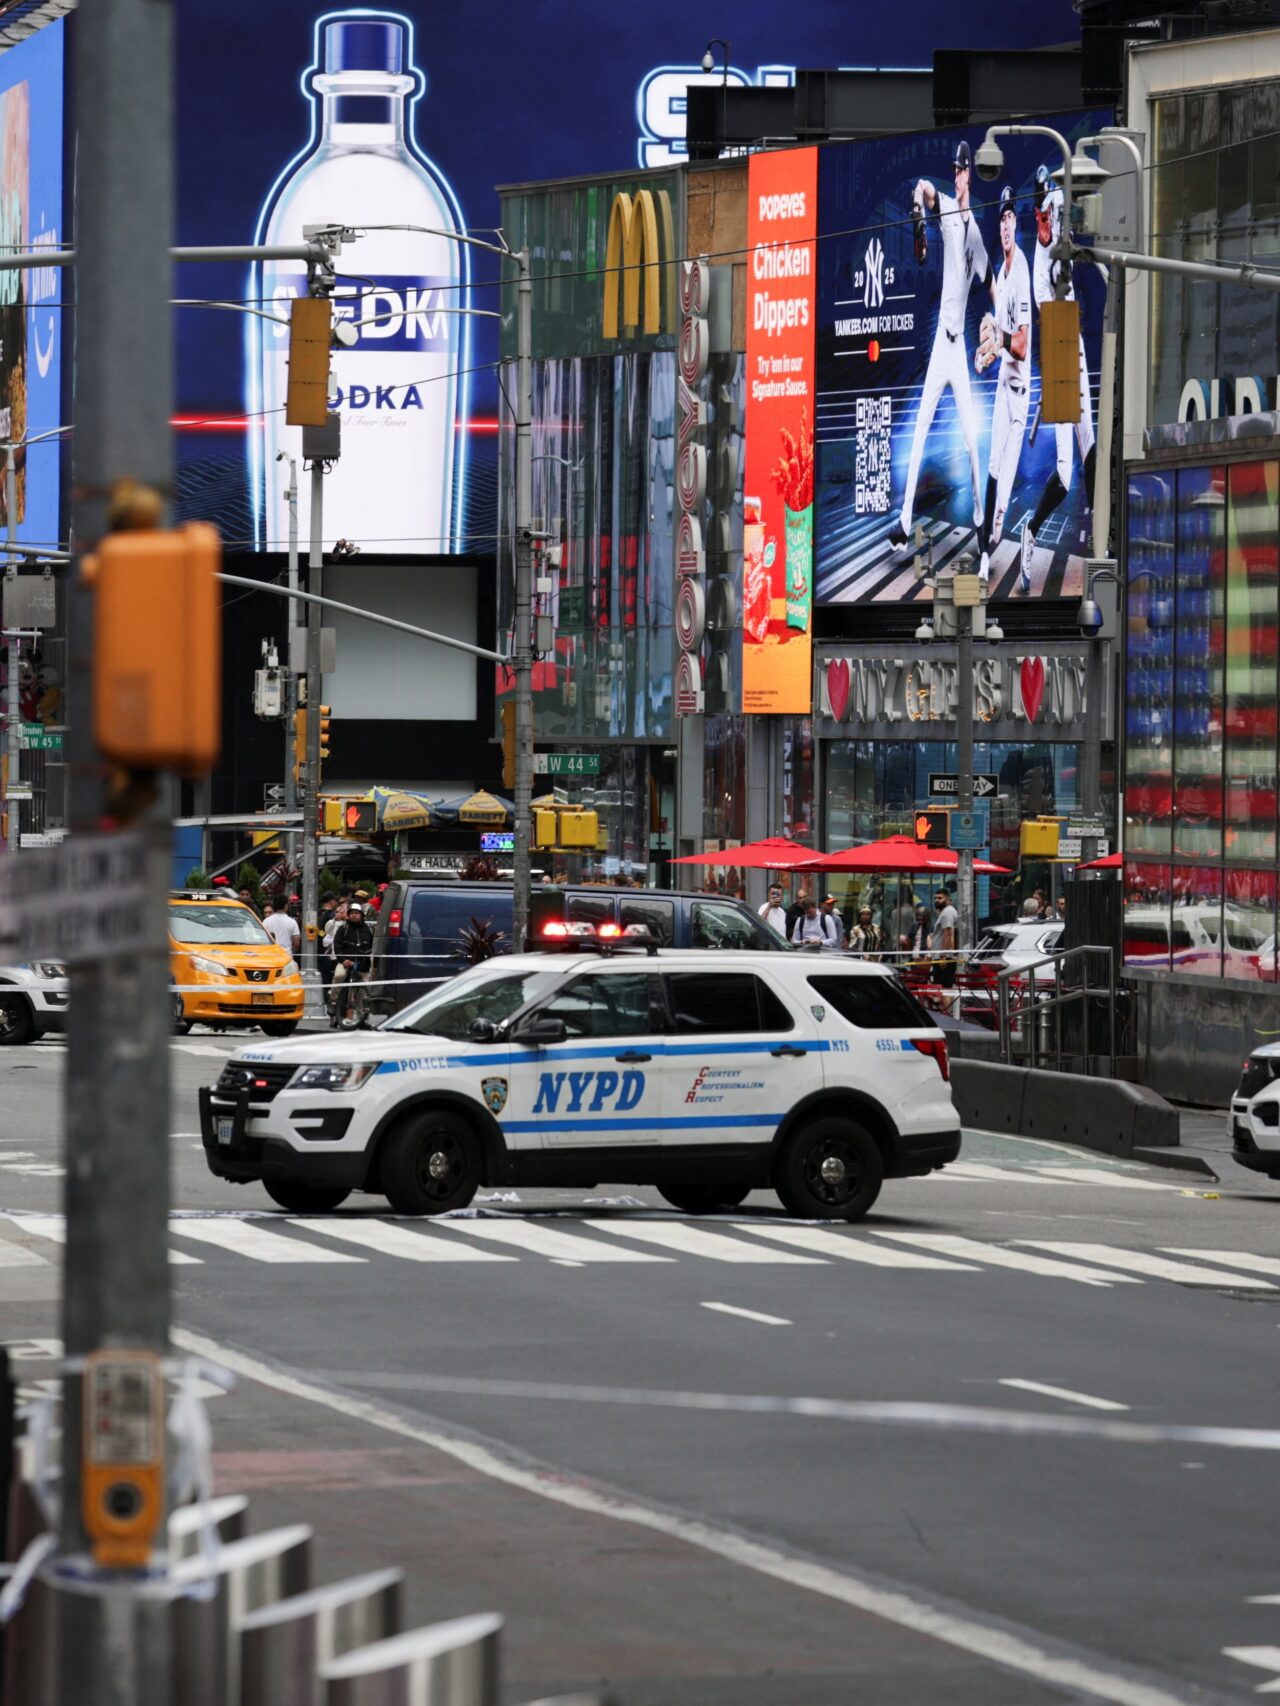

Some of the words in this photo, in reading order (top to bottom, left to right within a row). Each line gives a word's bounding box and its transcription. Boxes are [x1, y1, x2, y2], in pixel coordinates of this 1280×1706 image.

[753, 240, 810, 280] Chicken
[272, 286, 449, 340] SEDKA
[754, 292, 809, 337] Dippers
[834, 316, 878, 337] YANKEES.COM
[878, 315, 891, 332] FOR
[891, 313, 914, 332] TICKETS
[327, 385, 425, 410] ODKA
[905, 658, 1002, 722] GIFS
[31, 737, 38, 747] W
[41, 736, 53, 748] 45
[550, 757, 562, 772] W
[567, 757, 584, 772] 44
[588, 757, 598, 767] St
[938, 780, 959, 790] ONE
[972, 780, 989, 790] AY
[425, 856, 460, 869] HALAL
[399, 1057, 448, 1072] POLICE
[531, 1069, 646, 1113] NYPD
